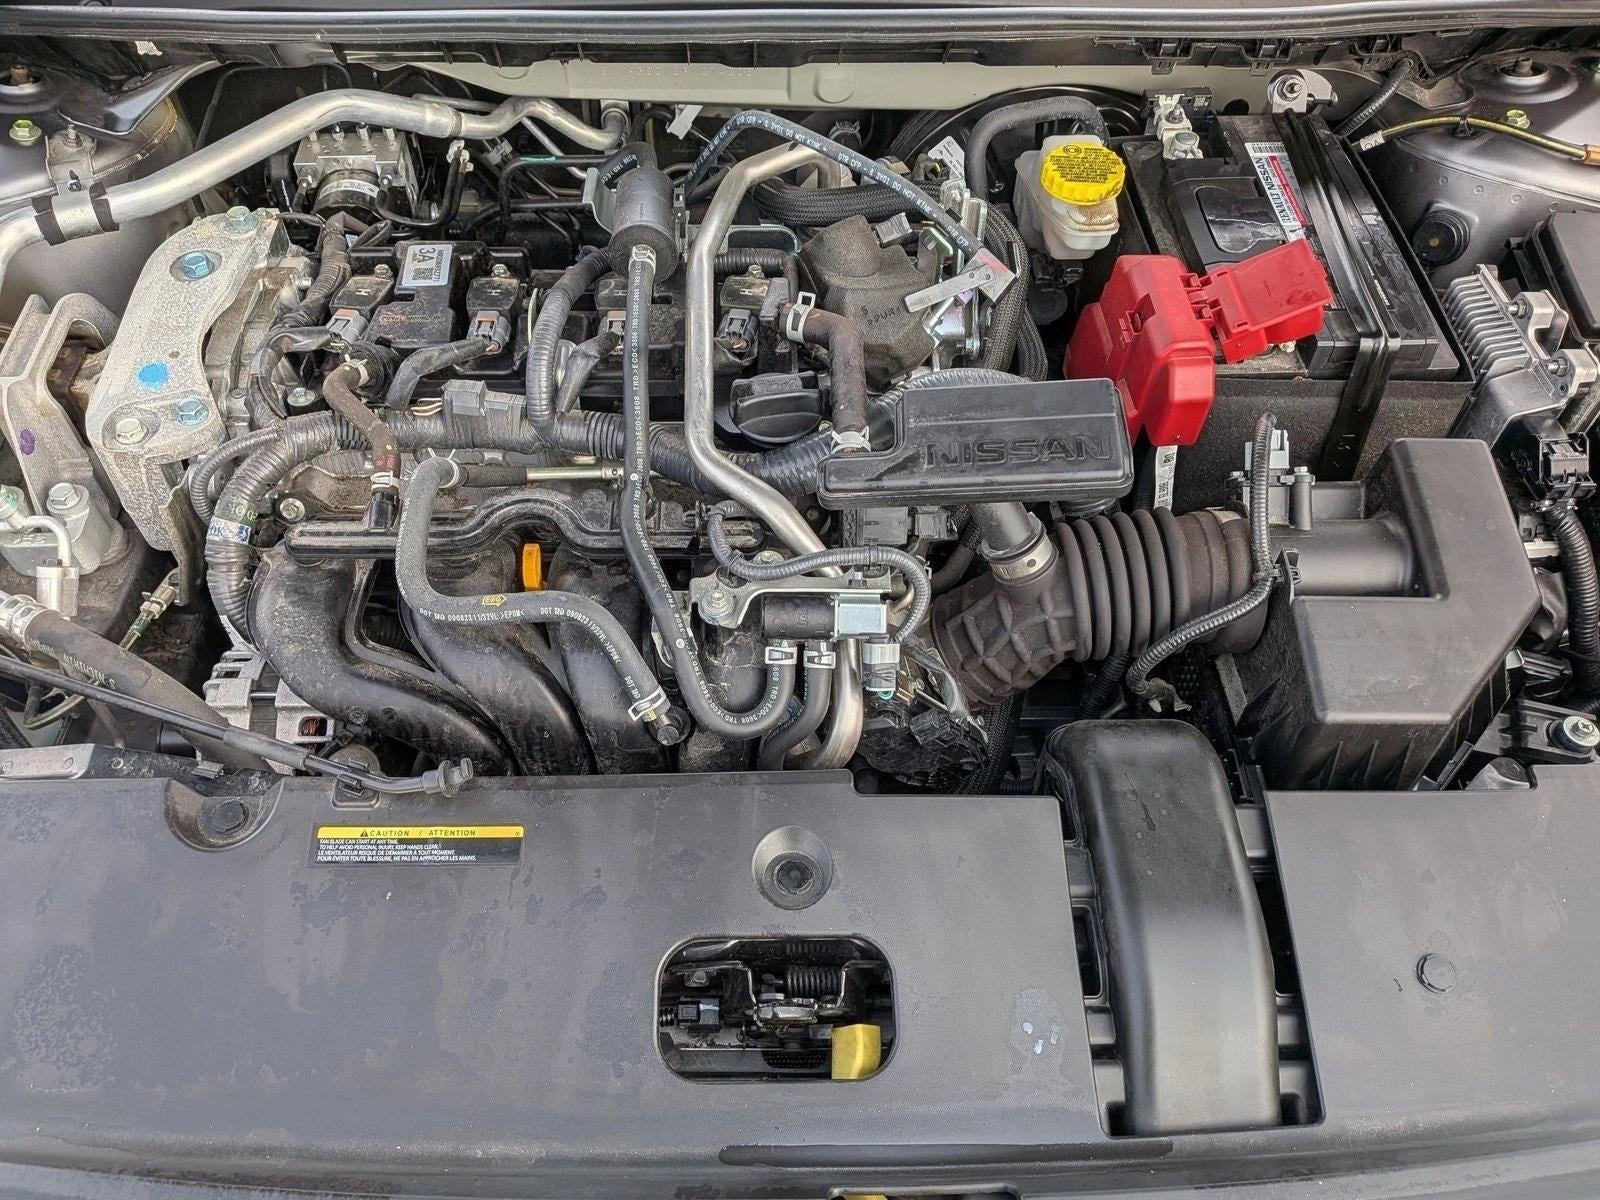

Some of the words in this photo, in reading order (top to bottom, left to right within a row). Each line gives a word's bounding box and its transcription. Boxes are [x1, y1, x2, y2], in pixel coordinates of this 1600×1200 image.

[1253, 156, 1277, 191] NISSAN
[902, 187, 917, 201] NOT
[916, 198, 934, 214] KINK
[925, 436, 1110, 468] NISSAN
[420, 608, 432, 618] DOT
[540, 606, 552, 615] DOT
[624, 675, 636, 690] DOT
